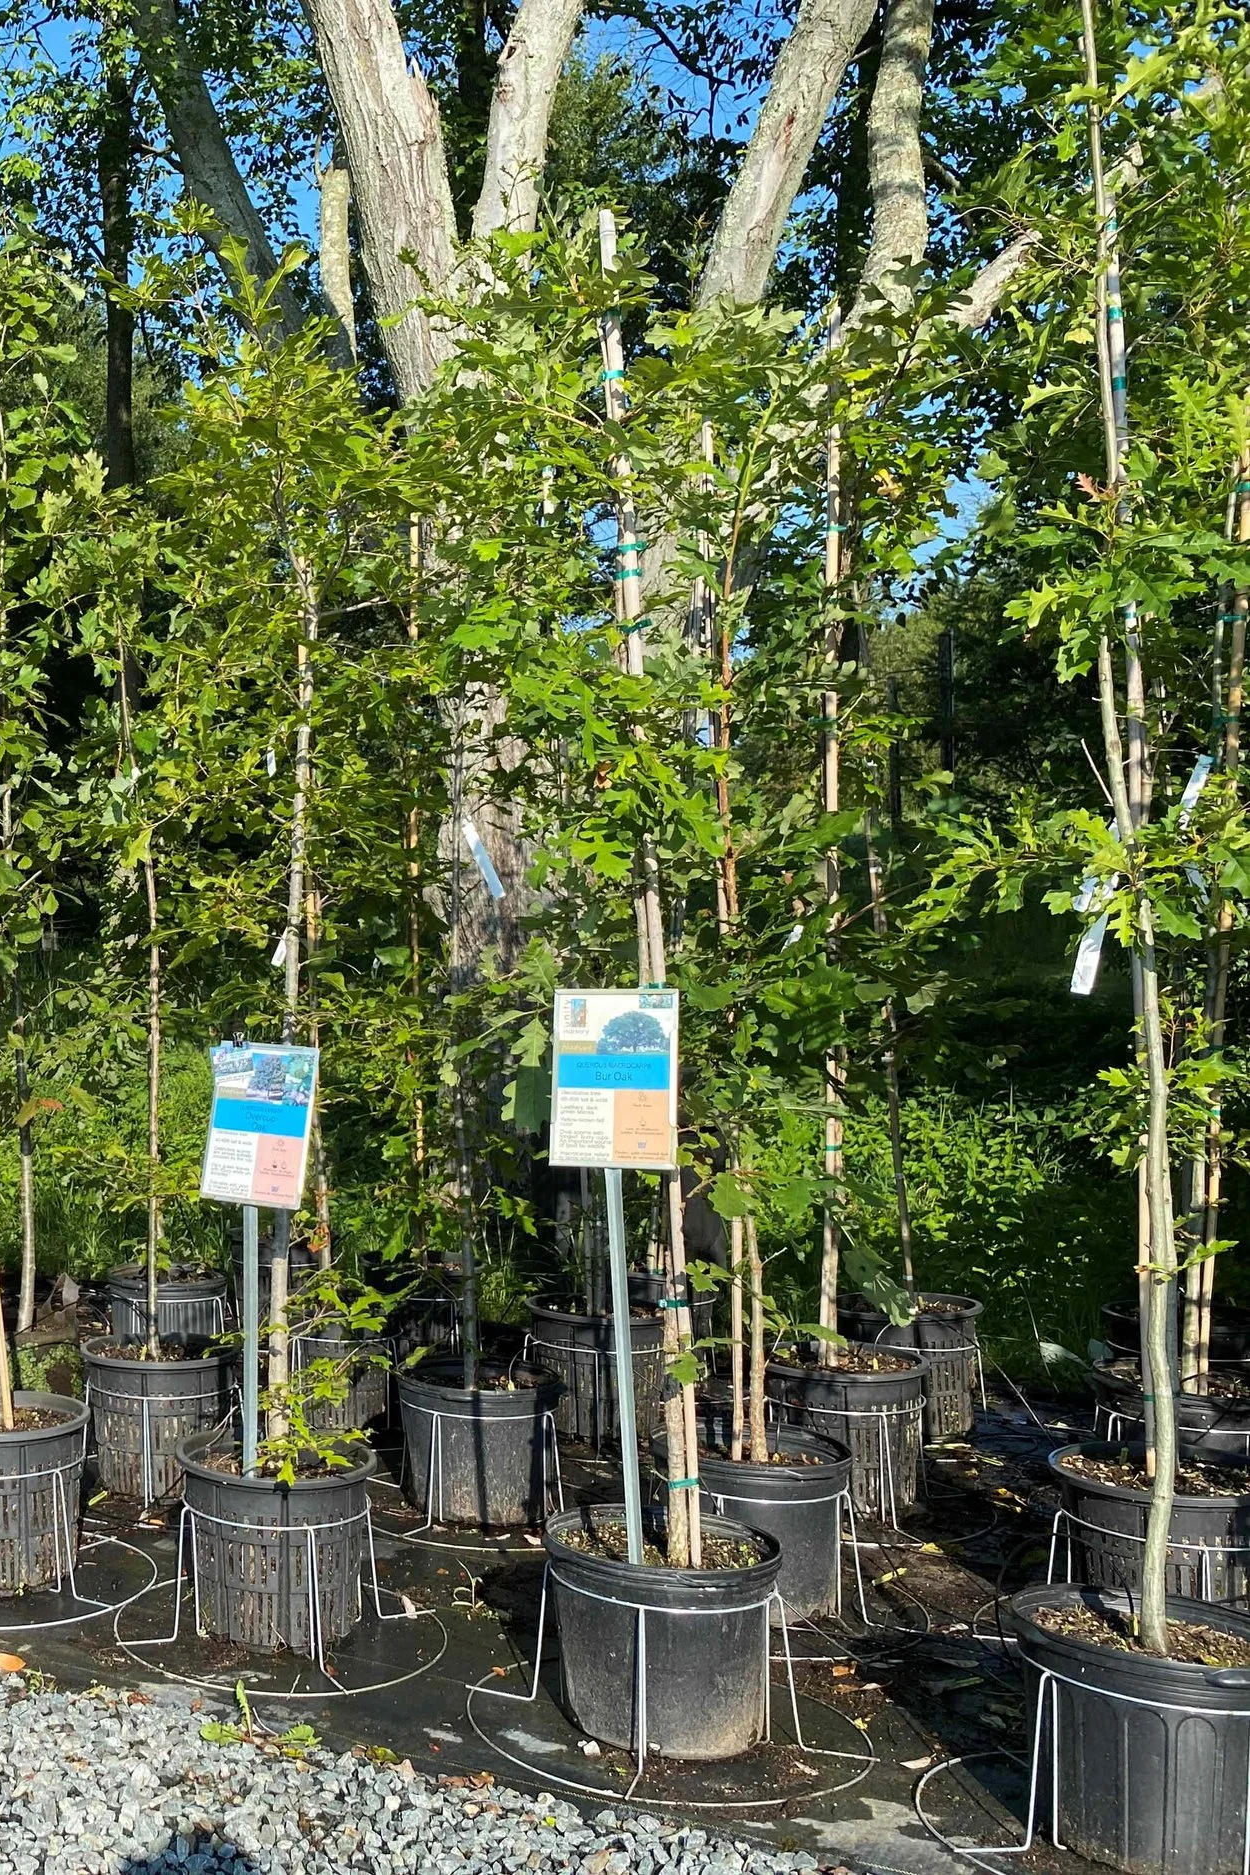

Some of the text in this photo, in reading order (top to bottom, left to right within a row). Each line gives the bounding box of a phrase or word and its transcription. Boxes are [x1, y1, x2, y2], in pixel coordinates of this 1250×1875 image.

[595, 1071, 632, 1081] Bur Oak
[246, 1111, 276, 1123] Overcup
